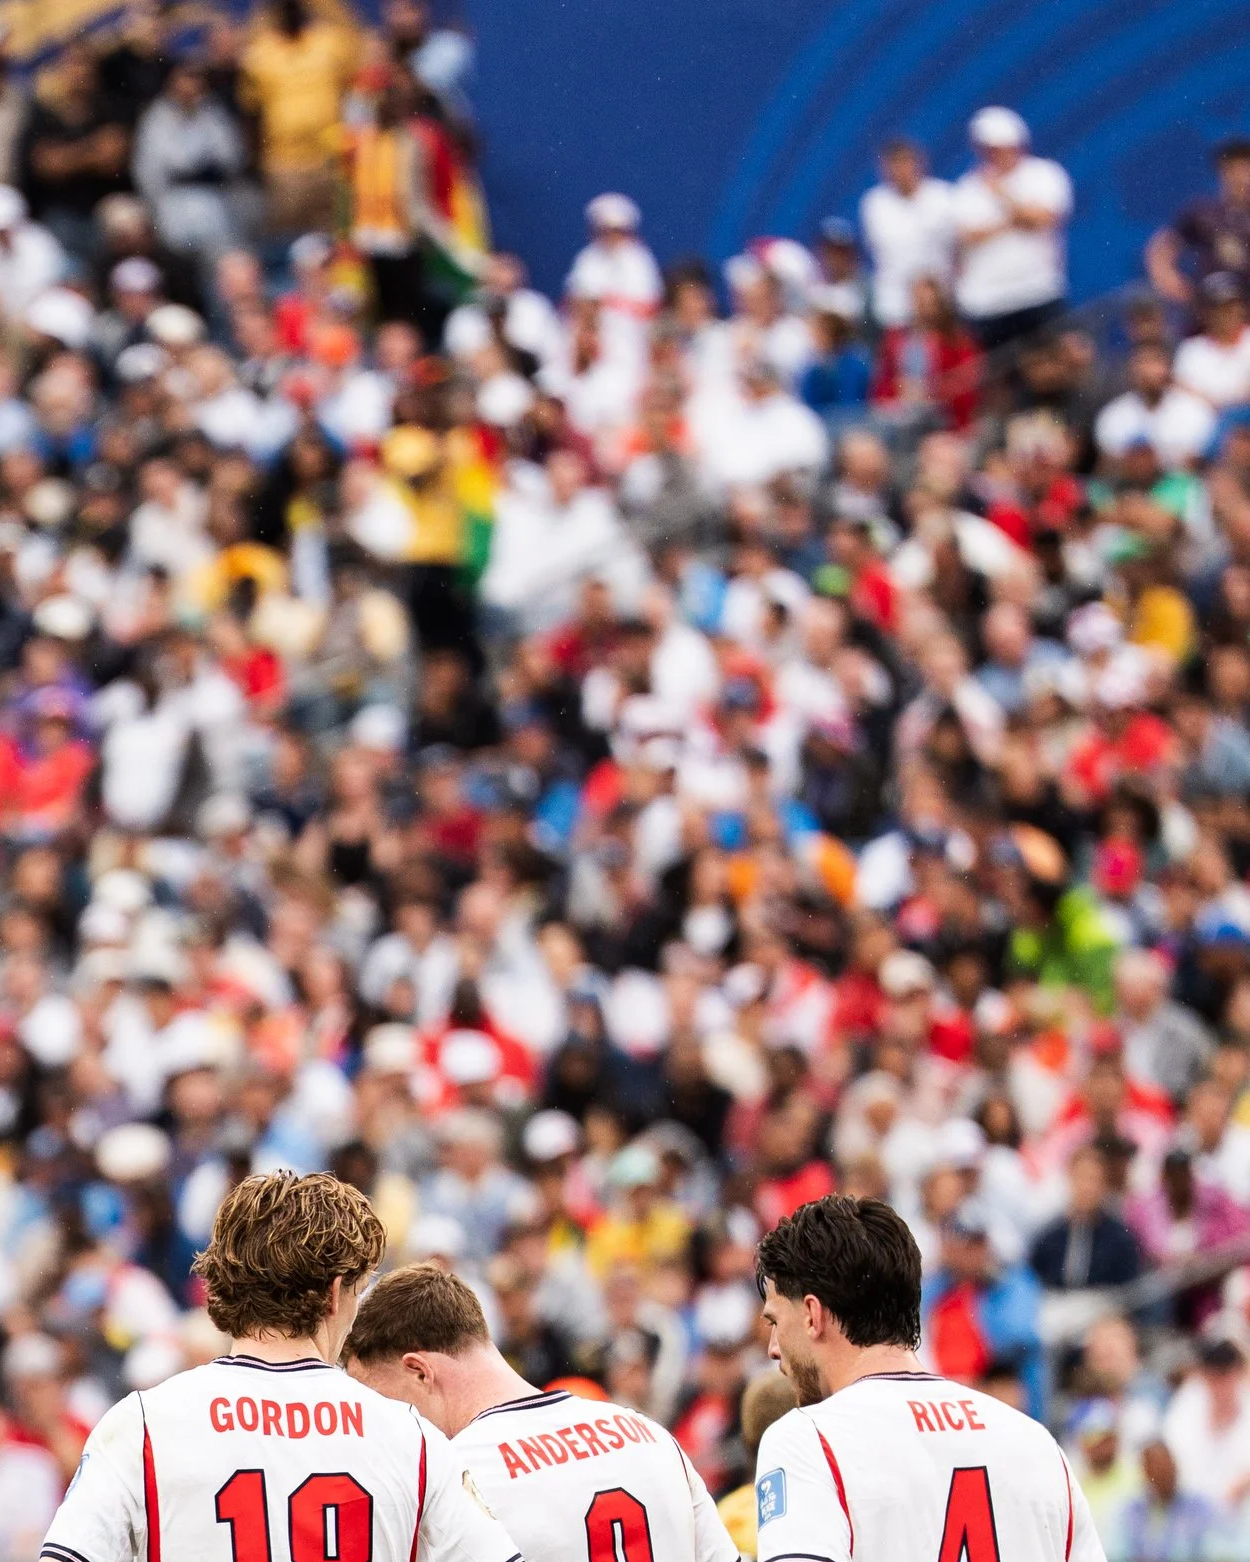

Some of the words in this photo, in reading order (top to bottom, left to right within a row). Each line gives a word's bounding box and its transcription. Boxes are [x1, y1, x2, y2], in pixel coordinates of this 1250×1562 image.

[209, 1396, 364, 1440] GORDON
[906, 1399, 986, 1434] RICE
[498, 1414, 658, 1480] ANDERSON
